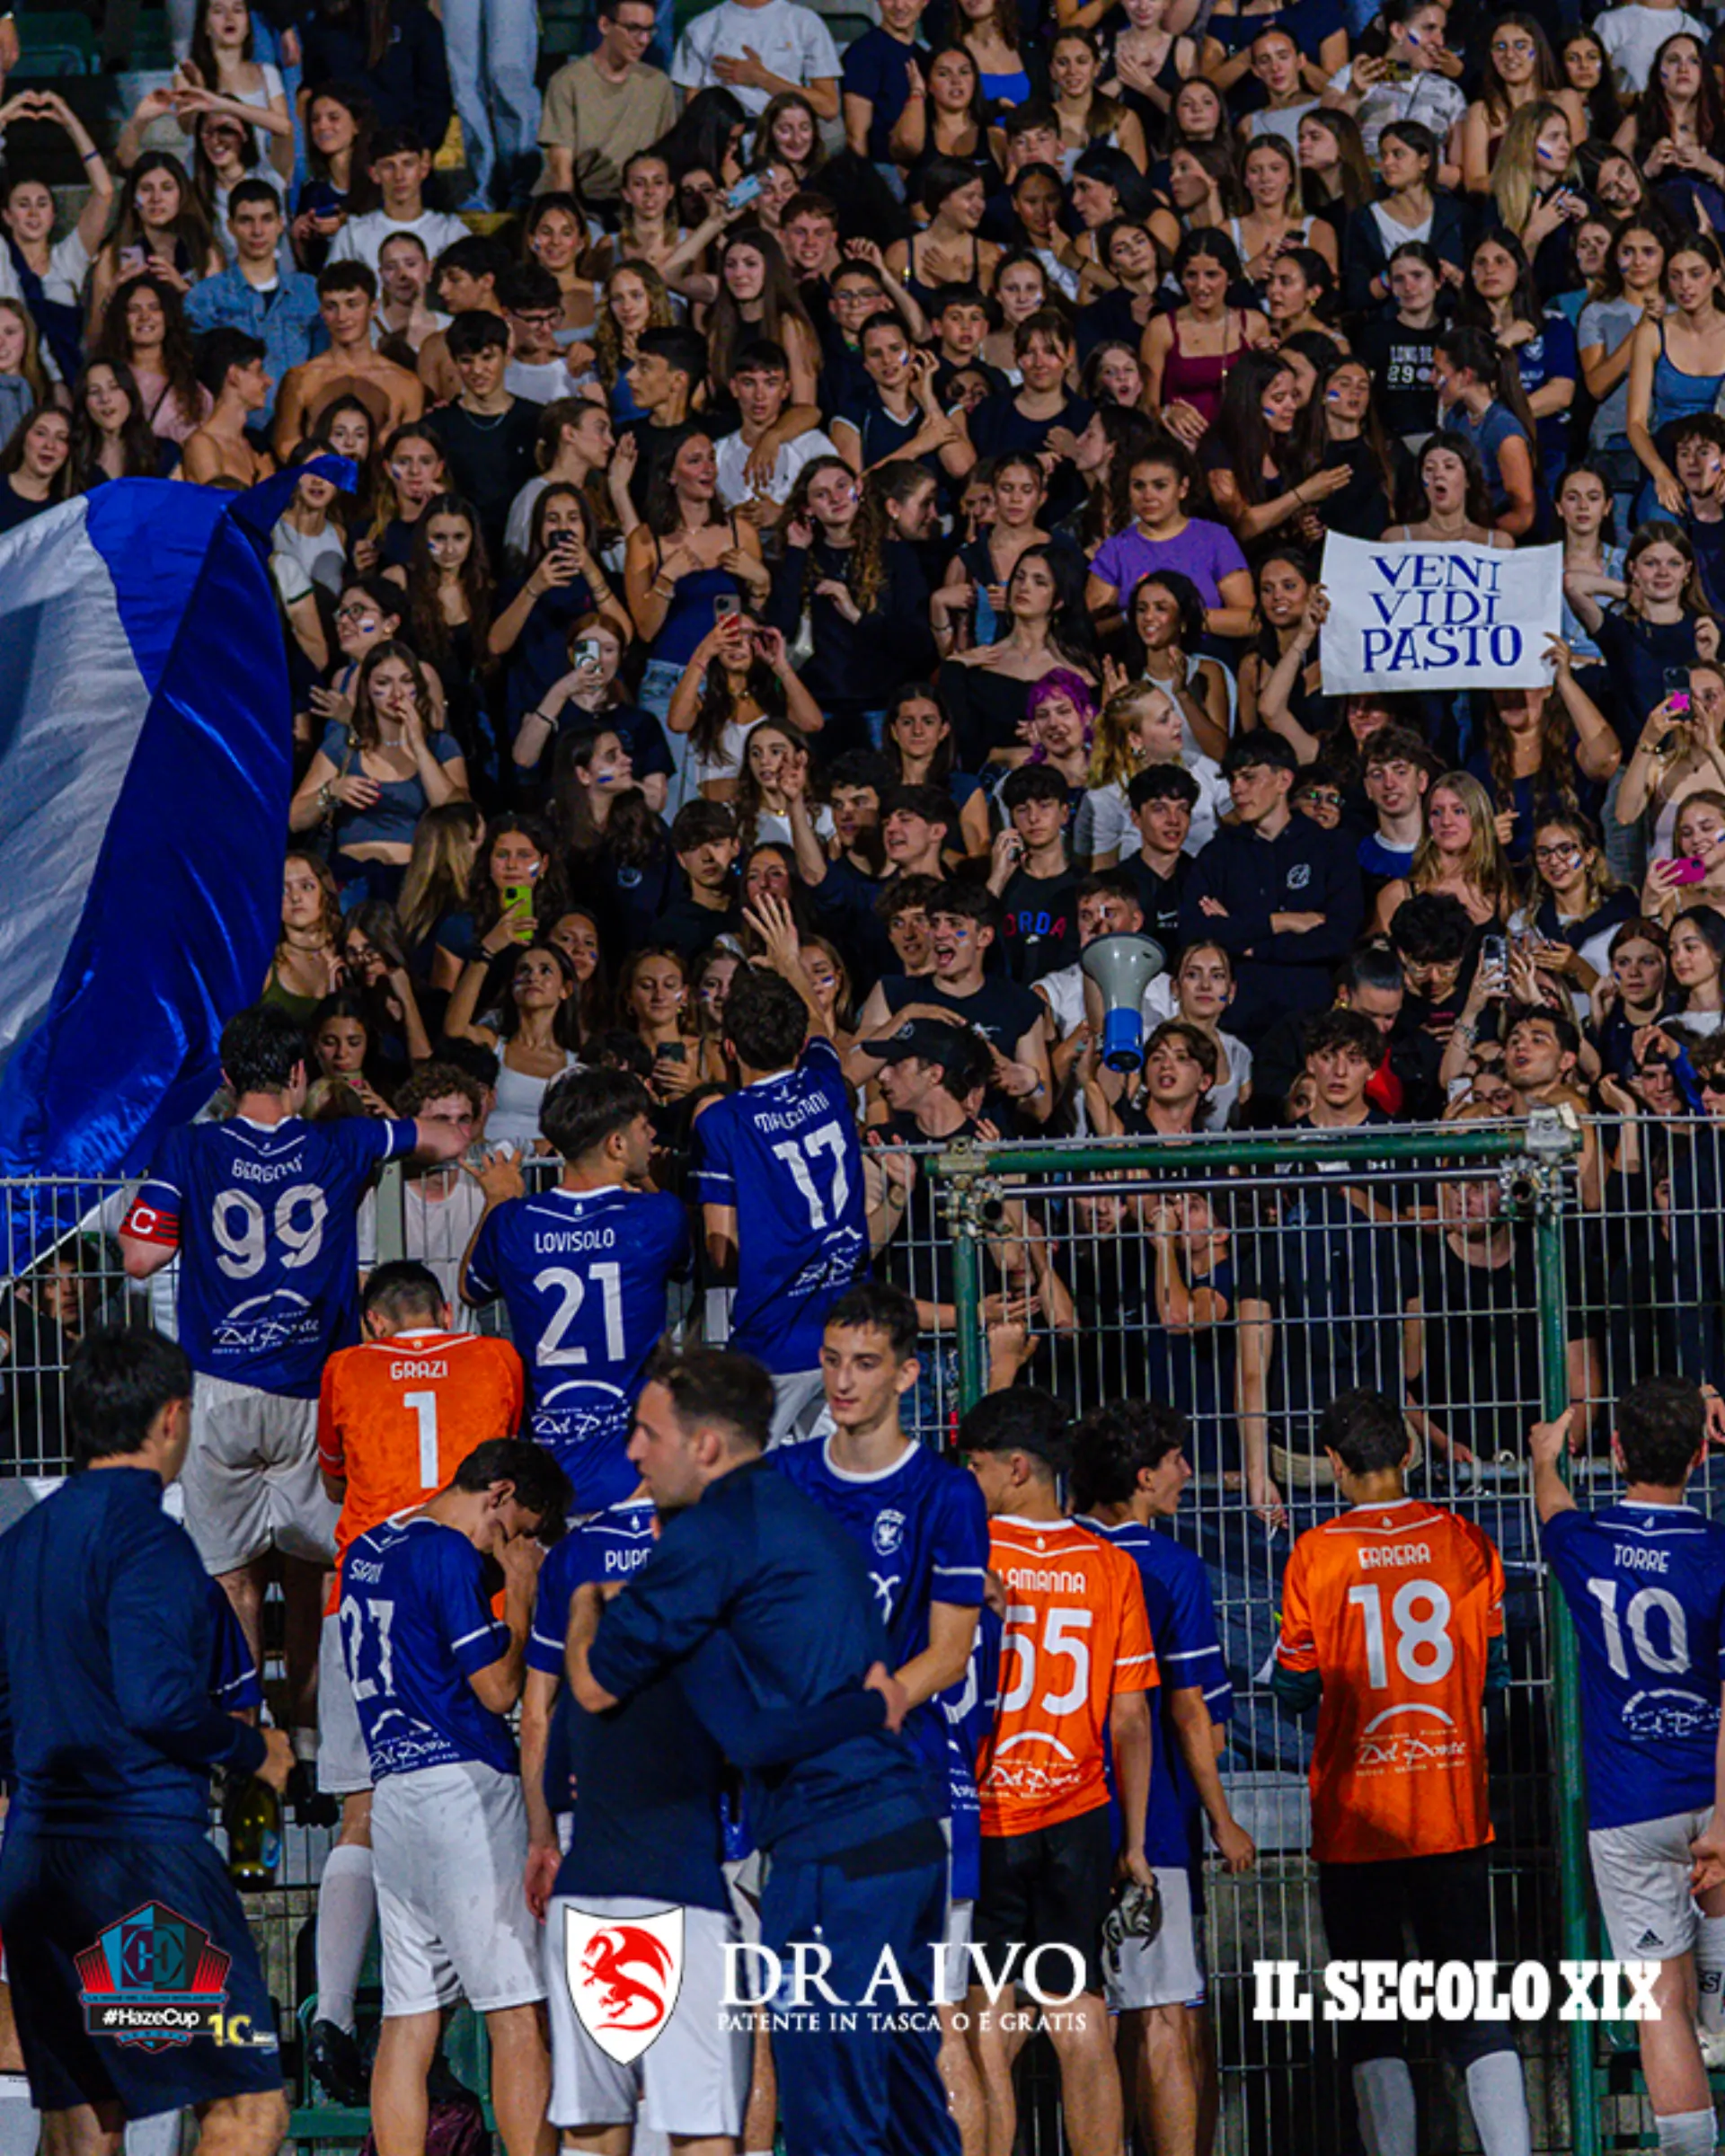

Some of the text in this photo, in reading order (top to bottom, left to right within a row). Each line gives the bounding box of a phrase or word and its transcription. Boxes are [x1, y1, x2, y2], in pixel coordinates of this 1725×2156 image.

[1369, 554, 1502, 592] VENI
[1368, 589, 1501, 626] VIDI
[1361, 624, 1523, 673] PASTO
[771, 1120, 849, 1230] 17
[130, 1208, 156, 1234] C
[212, 1183, 328, 1280] 99
[534, 1227, 615, 1254] LOVISOLO
[533, 1261, 625, 1367] 21
[390, 1360, 448, 1381] GRAZI
[403, 1391, 438, 1489] 1
[1358, 1542, 1431, 1570] ERRERA
[1614, 1543, 1671, 1573] TORRE
[1349, 1578, 1454, 1690] 18
[1587, 1577, 1692, 1680] 10
[996, 1604, 1092, 1716] 55
